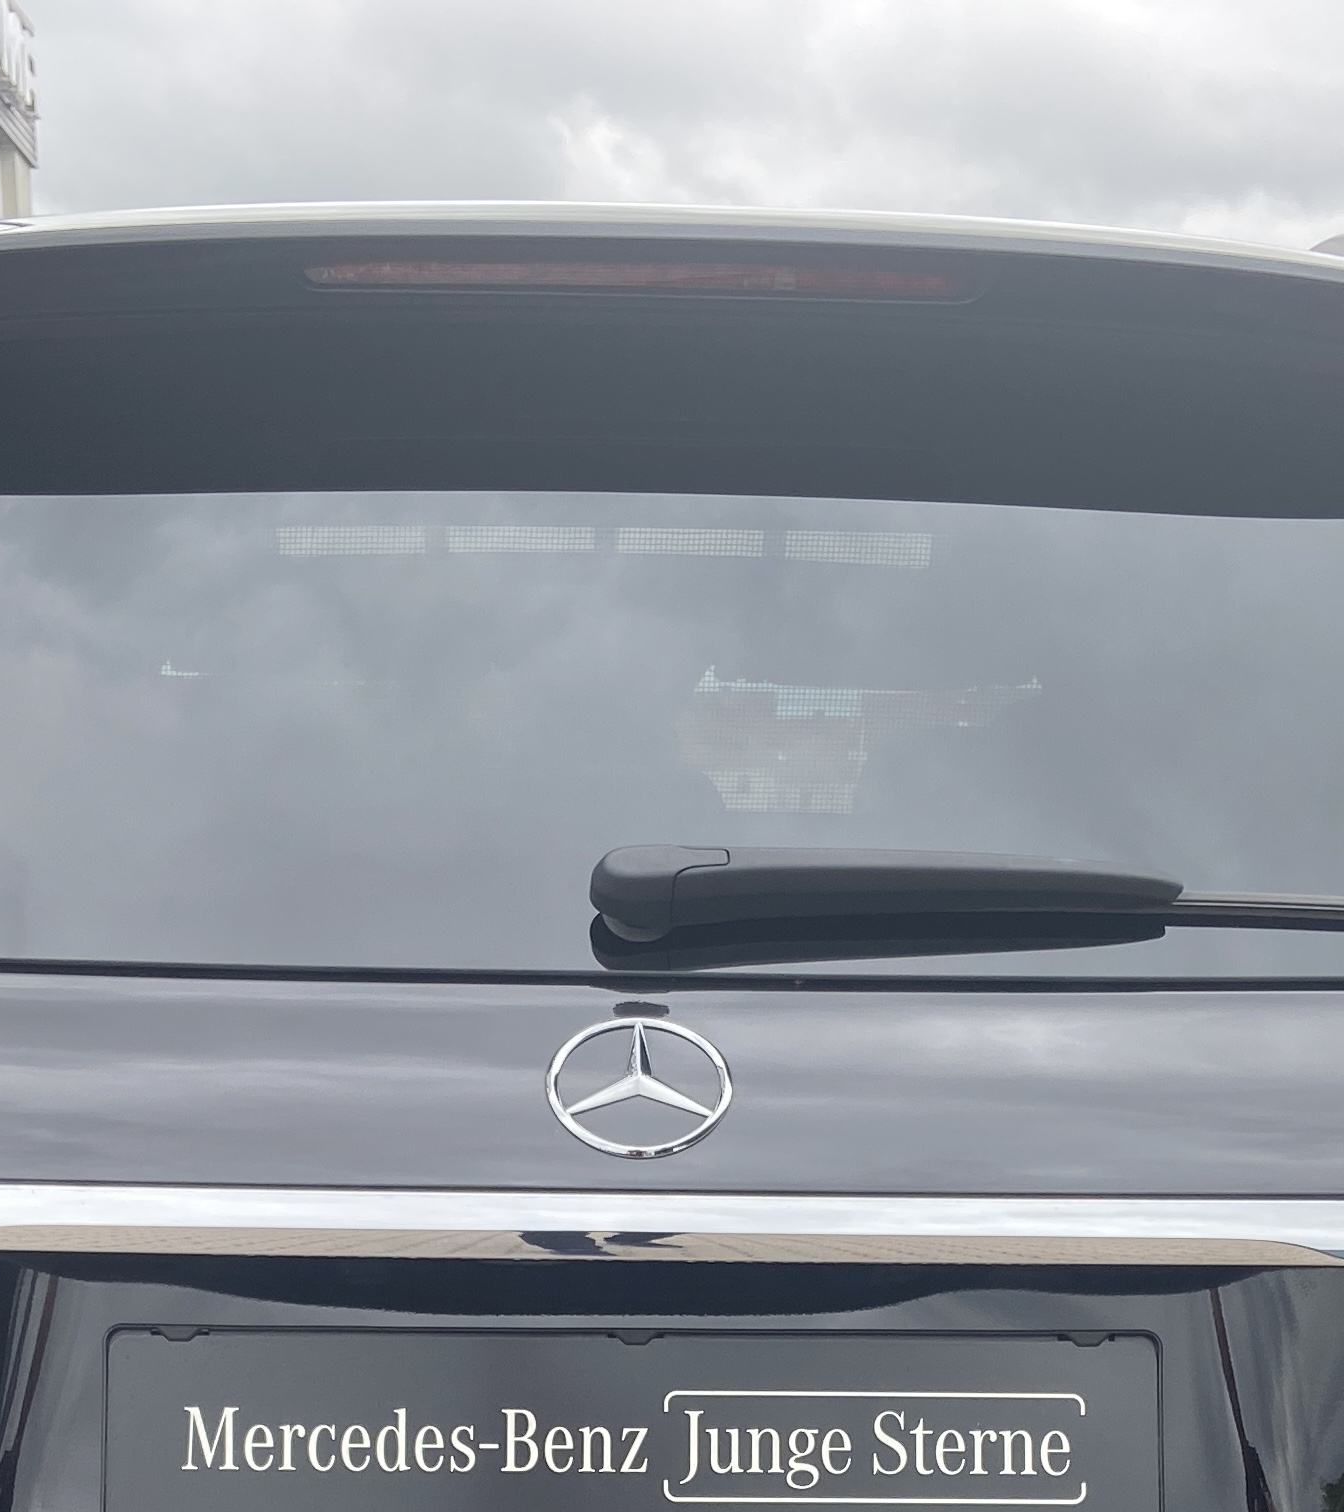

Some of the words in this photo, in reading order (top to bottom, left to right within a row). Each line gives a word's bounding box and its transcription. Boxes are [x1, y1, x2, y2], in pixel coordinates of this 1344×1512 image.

[181, 1406, 649, 1474] Mercedes-Benz
[679, 1410, 853, 1489] Junge
[872, 1410, 1072, 1476] Sterne
